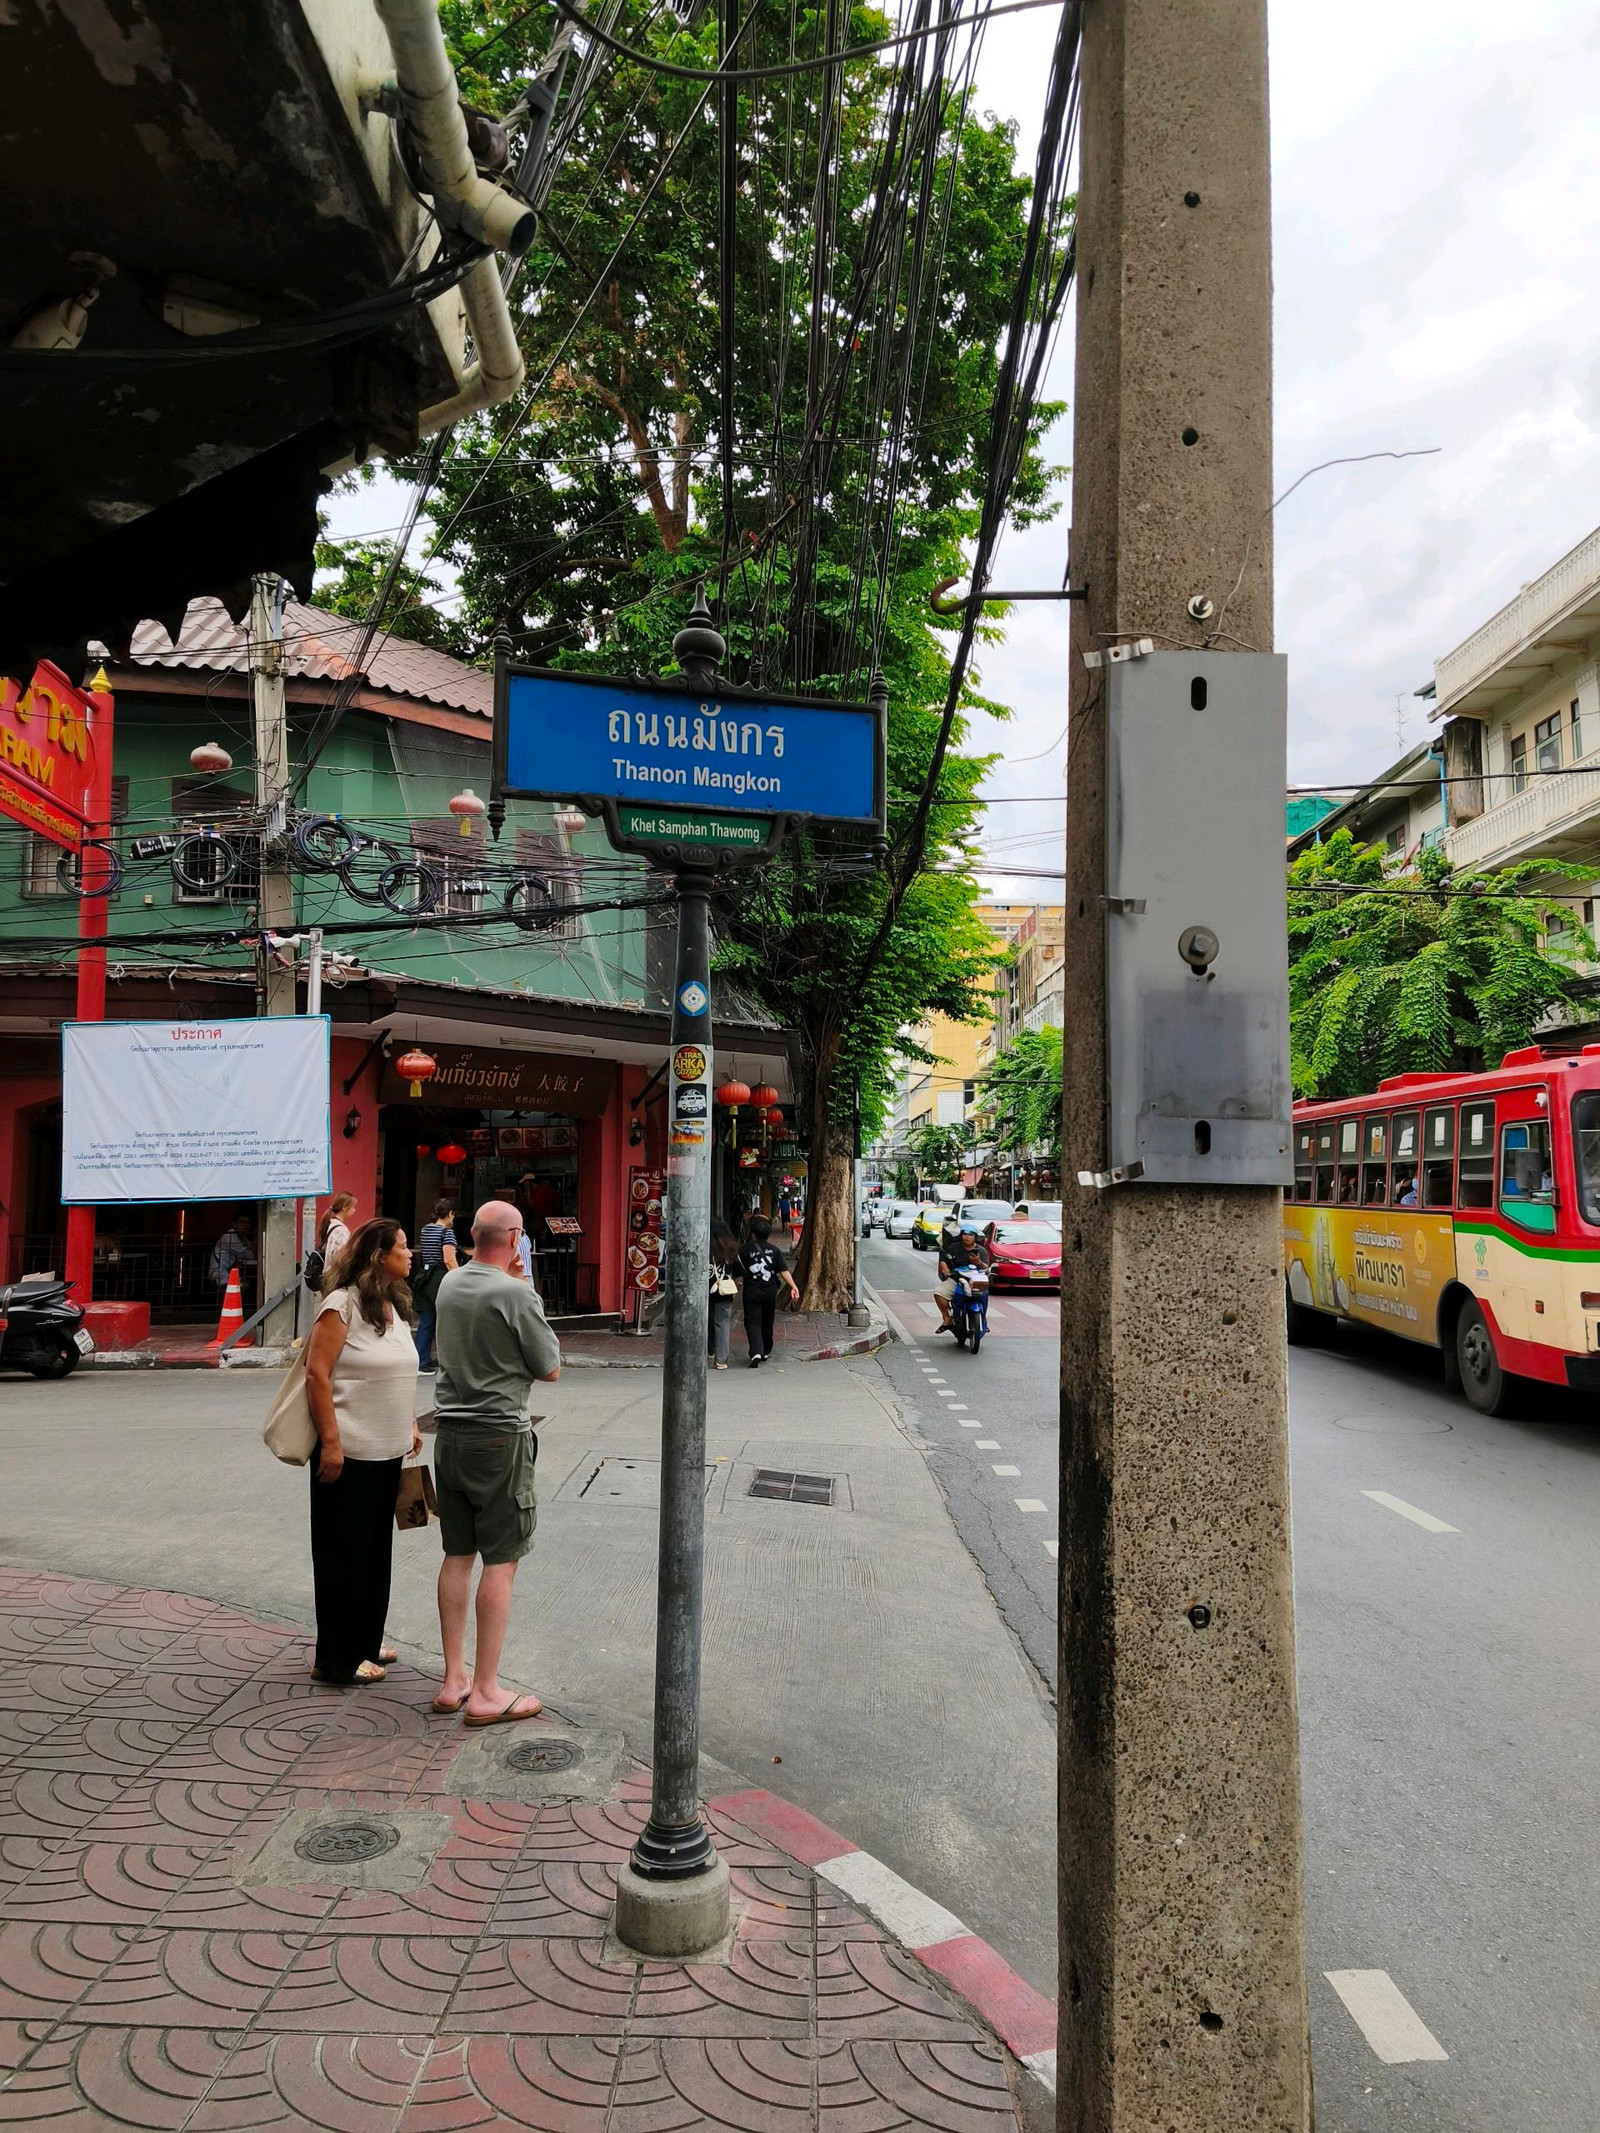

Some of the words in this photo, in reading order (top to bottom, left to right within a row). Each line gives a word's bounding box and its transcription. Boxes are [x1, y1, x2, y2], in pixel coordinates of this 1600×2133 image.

[608, 703, 784, 758] ถนนมังกร
[612, 758, 687, 785] Thanon
[693, 766, 781, 795] Mangkon
[631, 817, 656, 833] Khet
[658, 819, 707, 838] Samphan
[171, 1027, 222, 1040] ประกาศ
[674, 1058, 705, 1069] ARKA
